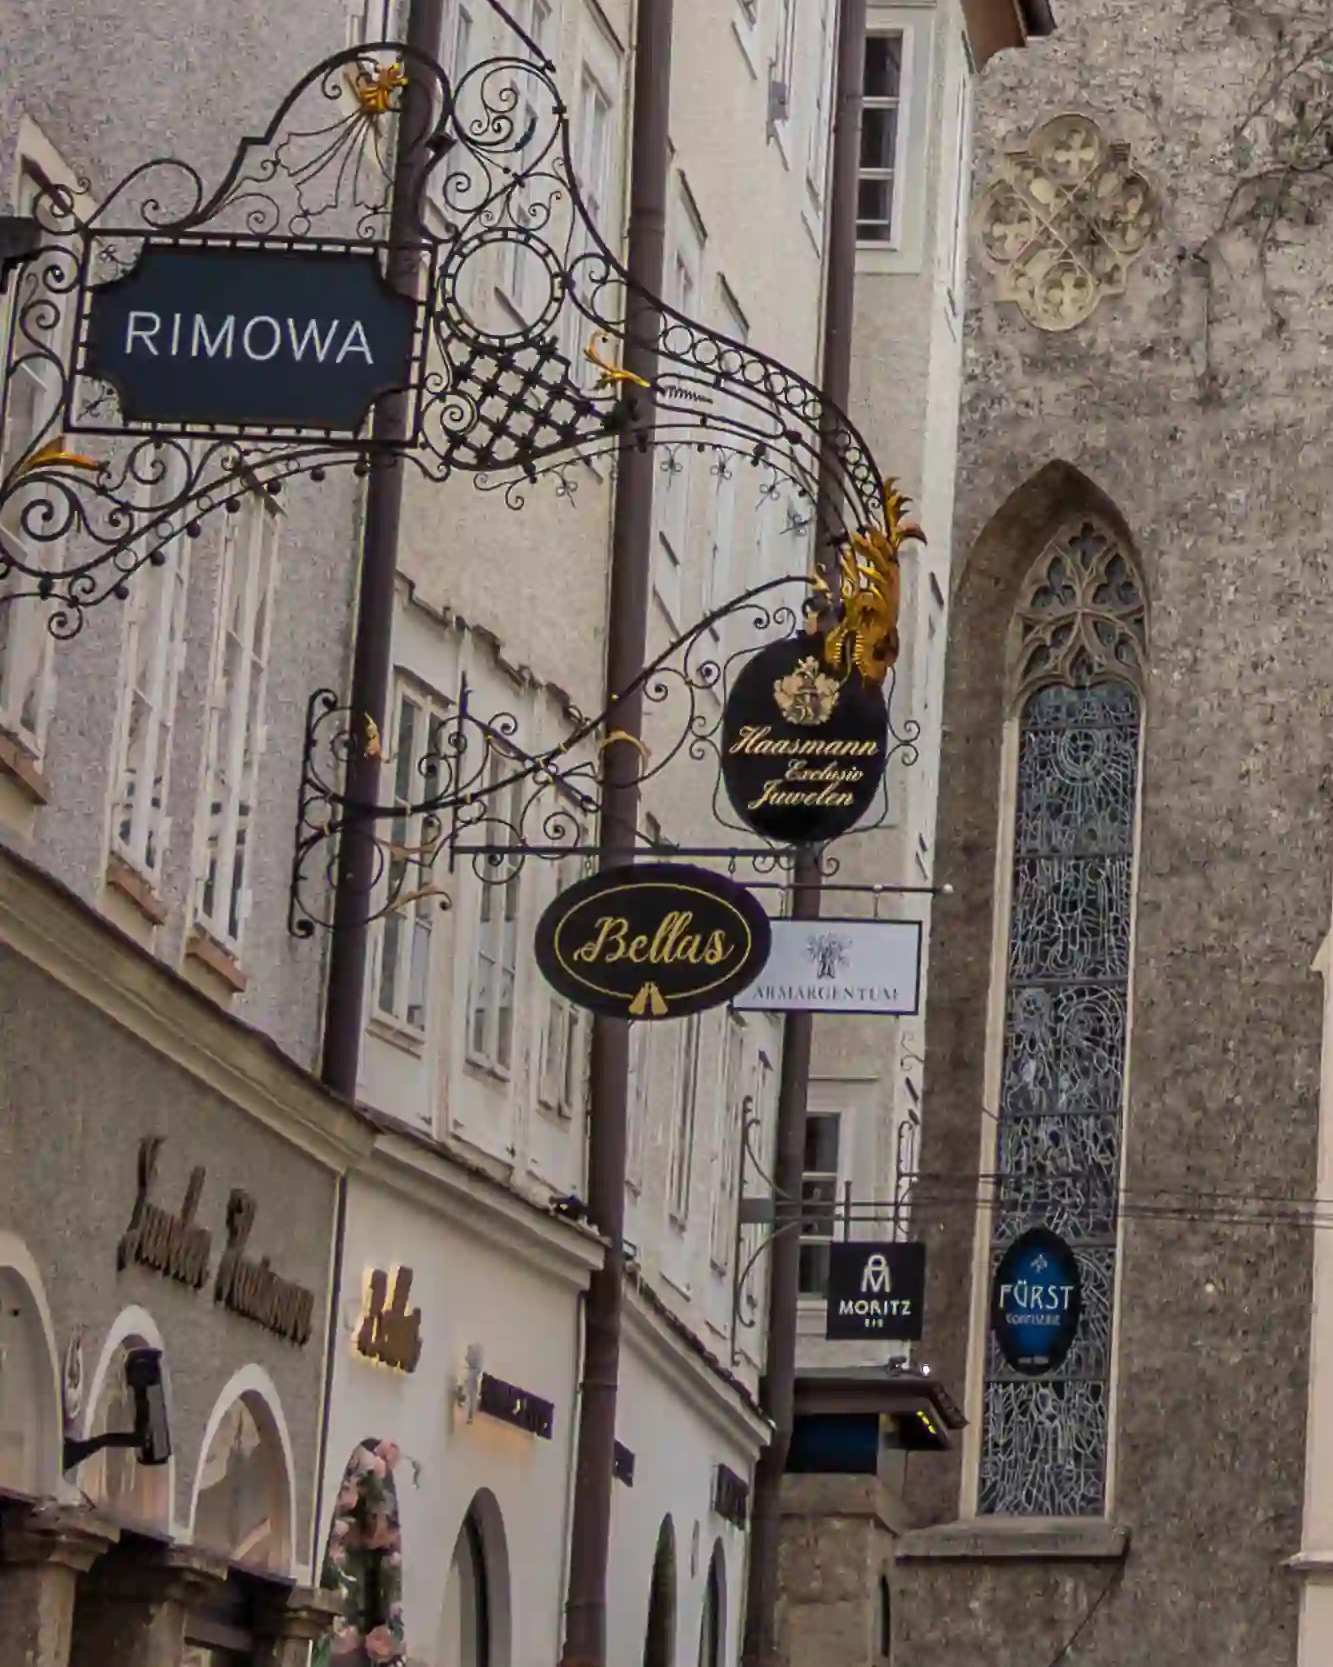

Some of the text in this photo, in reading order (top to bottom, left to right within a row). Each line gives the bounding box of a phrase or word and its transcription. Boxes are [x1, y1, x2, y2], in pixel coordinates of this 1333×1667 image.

[124, 310, 375, 364] RIMOWA
[729, 725, 880, 756] Haasmann
[747, 778, 855, 810] Juwelen
[573, 911, 736, 966] Bellas
[839, 1299, 912, 1316] MORITZ
[1000, 1279, 1075, 1311] FÜRST
